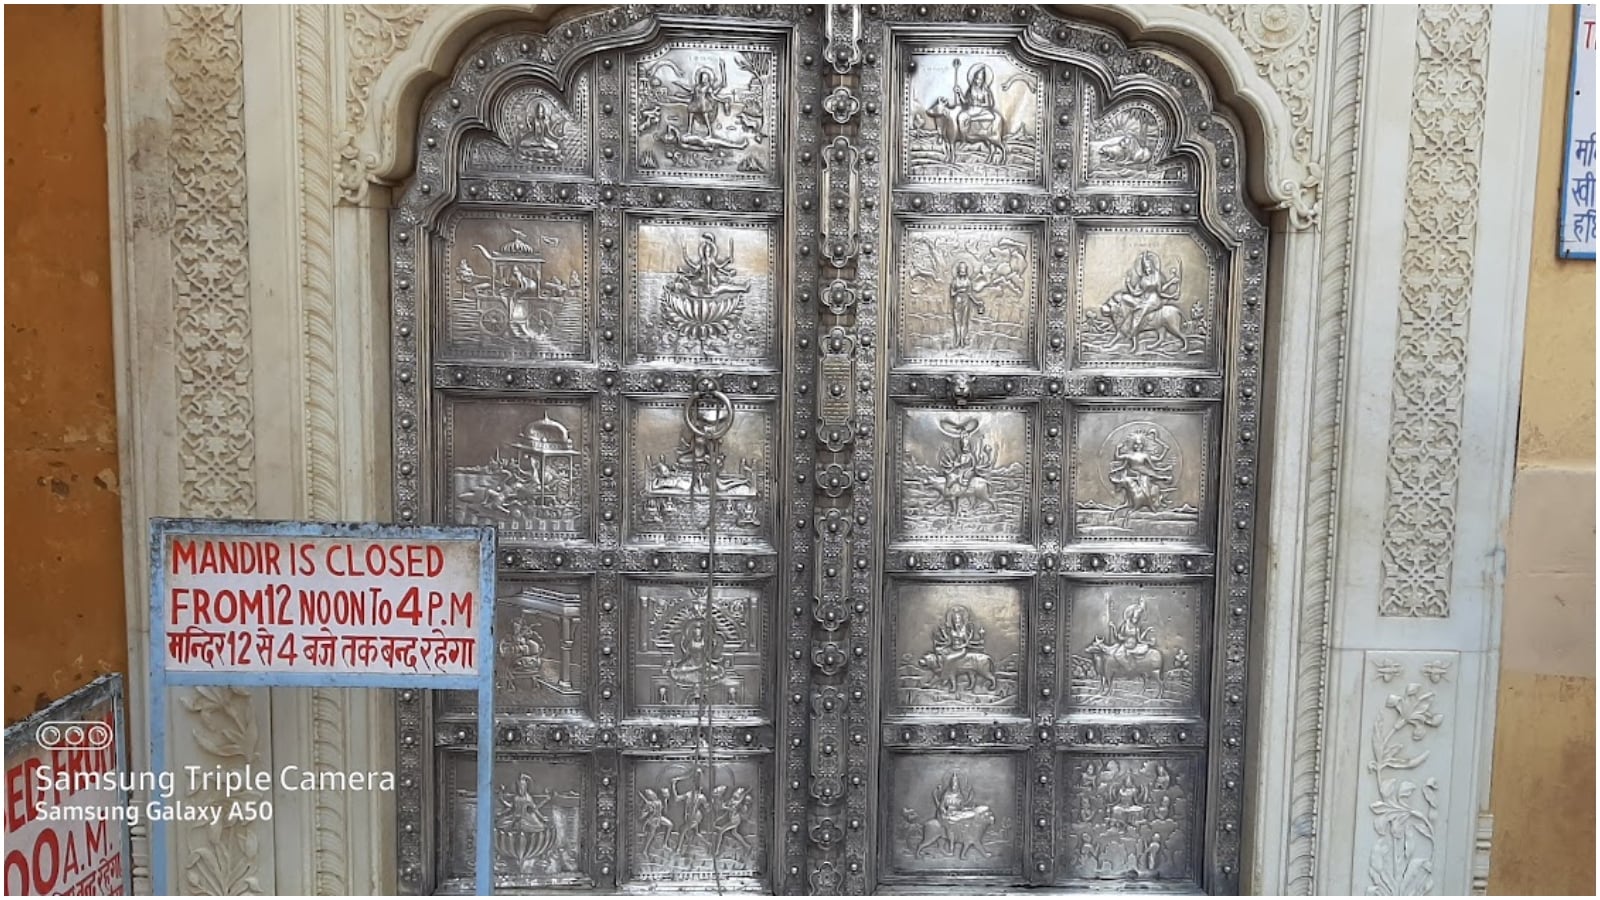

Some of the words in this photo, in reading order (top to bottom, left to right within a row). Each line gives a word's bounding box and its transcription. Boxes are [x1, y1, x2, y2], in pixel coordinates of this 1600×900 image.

[171, 540, 281, 575] MANDIR
[290, 543, 316, 576] IS
[325, 543, 445, 577] CLOSED
[171, 588, 265, 625] FROM
[264, 584, 294, 625] 12
[298, 590, 365, 626] NOON
[396, 586, 423, 626] 4
[428, 591, 473, 628] P.M
[166, 625, 226, 669] मन्दिर
[226, 631, 252, 666] 12
[255, 627, 275, 666] से
[277, 632, 298, 666] 4
[302, 626, 338, 667] बजे
[341, 635, 378, 668] तक
[380, 636, 418, 673] बन्द
[420, 628, 476, 673] रहेगा
[4, 757, 46, 833] ED
